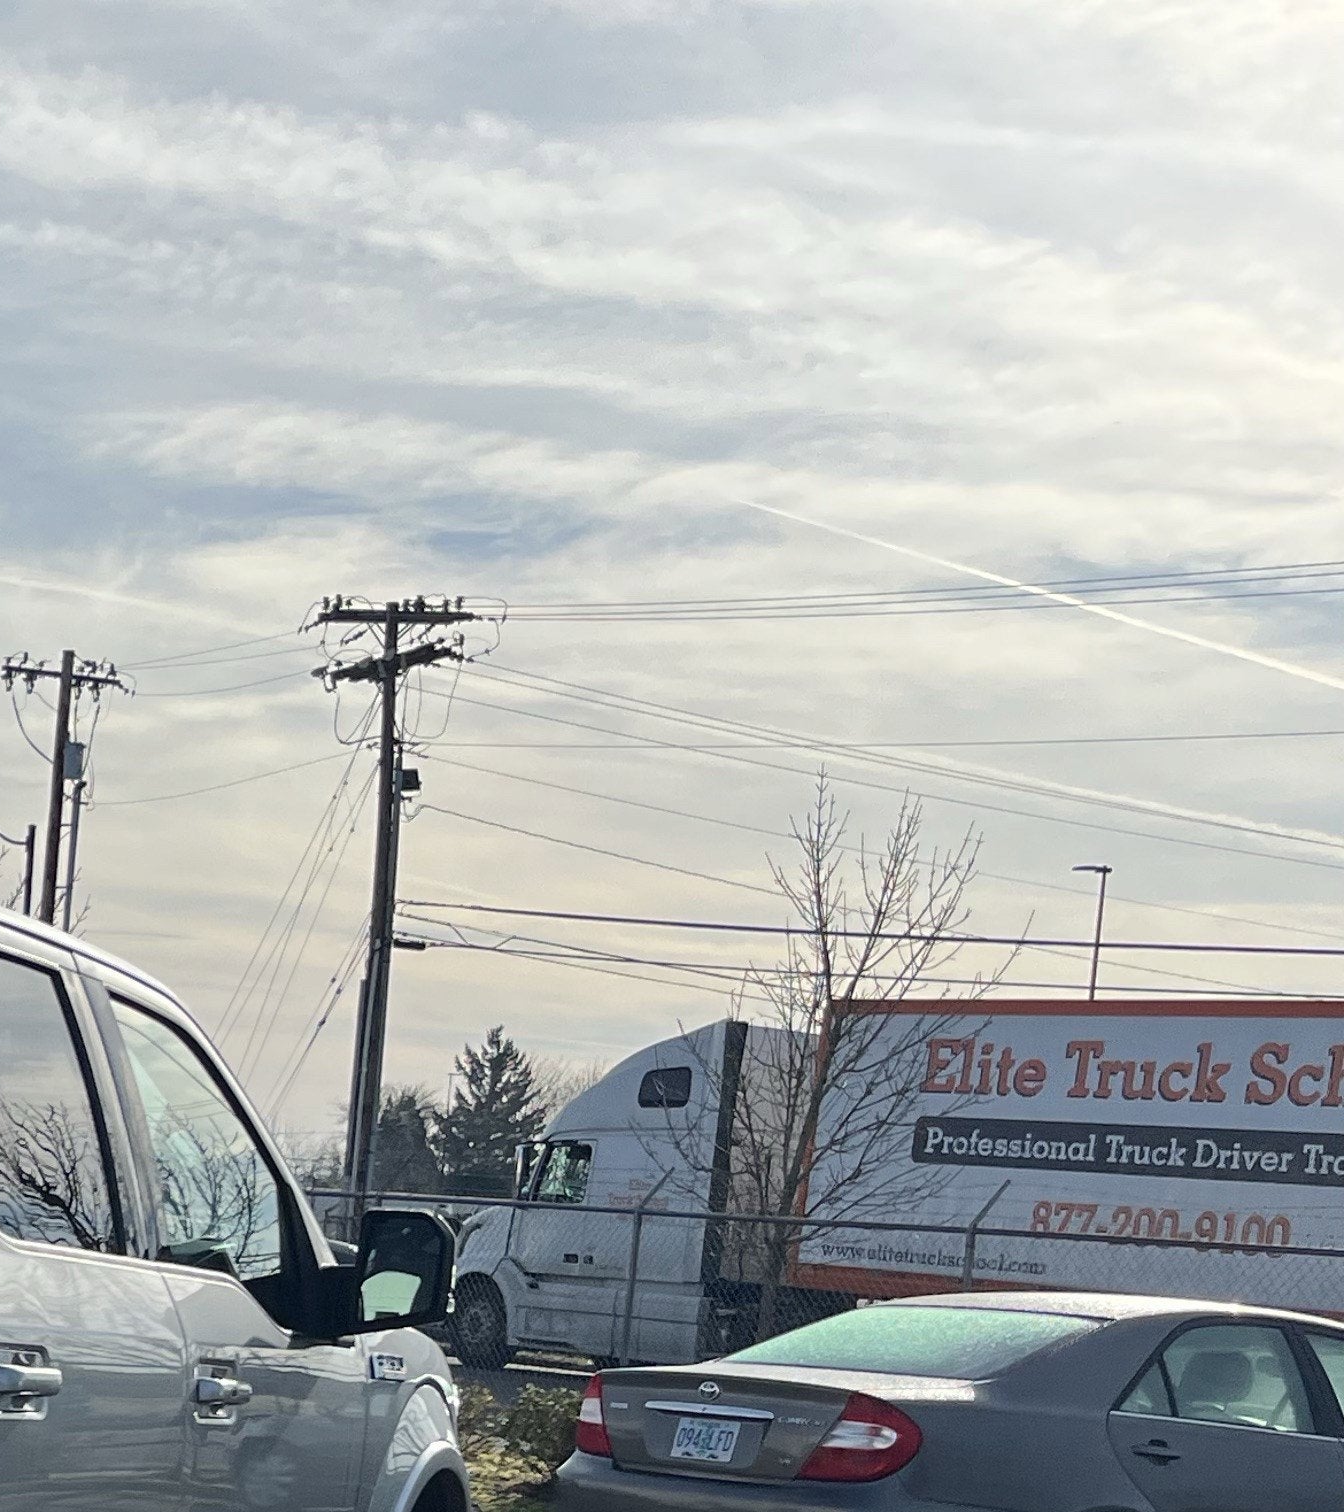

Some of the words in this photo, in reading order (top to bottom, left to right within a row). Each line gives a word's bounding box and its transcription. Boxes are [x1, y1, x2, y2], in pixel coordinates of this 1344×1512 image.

[919, 1037, 1047, 1097] Elite
[1065, 1040, 1232, 1104] Truck
[925, 1127, 1095, 1162] Professional
[1106, 1133, 1185, 1168] Truck
[1193, 1140, 1294, 1174] Driver
[1031, 1201, 1292, 1259] 877-200-9100
